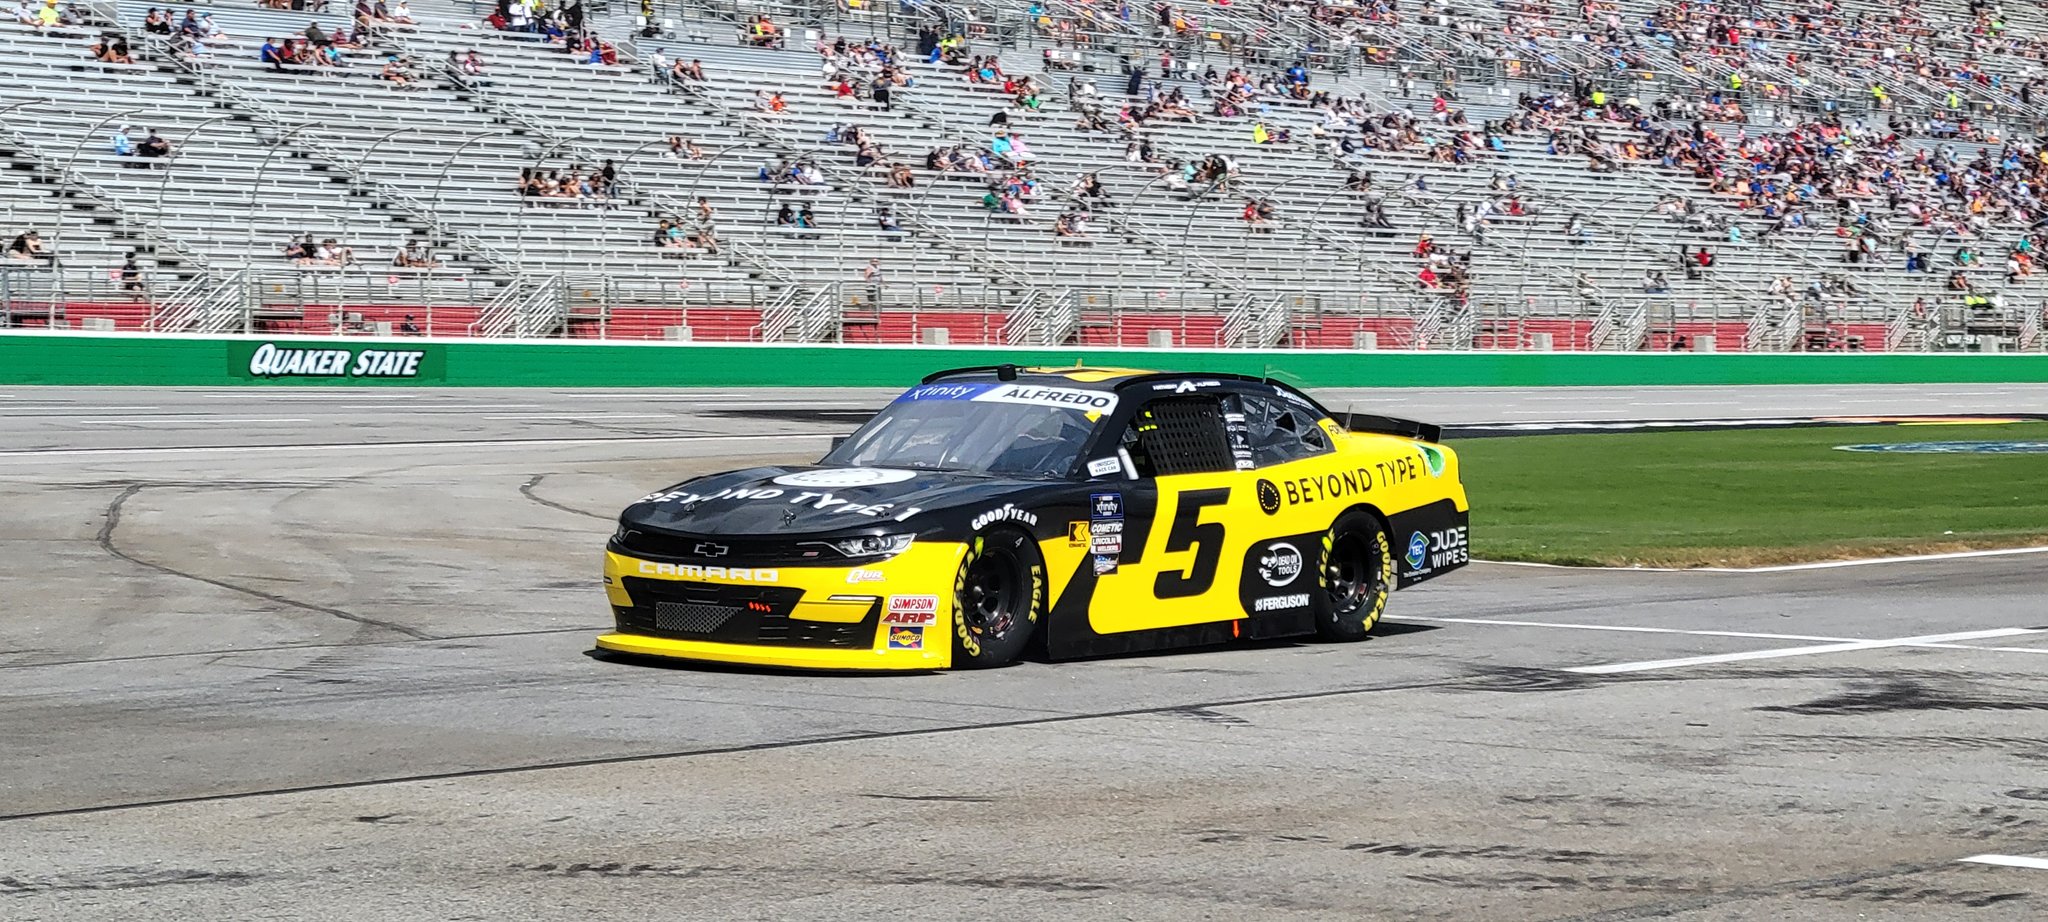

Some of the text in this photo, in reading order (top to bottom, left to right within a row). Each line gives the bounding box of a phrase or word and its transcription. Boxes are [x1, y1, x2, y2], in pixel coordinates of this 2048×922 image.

[250, 343, 424, 375] QUAKER STATE
[908, 385, 976, 400] xfinity
[1002, 388, 1110, 409] ALFREDO
[1284, 467, 1372, 506] BEYOND
[1376, 456, 1416, 488] TYPE
[790, 492, 894, 516] TYPE
[895, 507, 922, 522] 1
[1096, 501, 1118, 513] xfinity
[1091, 523, 1123, 533] COMETIC
[1092, 537, 1117, 545] LINCOLN
[1153, 487, 1232, 600] 5
[1431, 526, 1467, 552] DUDE
[1411, 544, 1423, 556] TEC
[1431, 547, 1468, 569] WIPES
[639, 561, 779, 582] CAMARO
[1278, 565, 1298, 576] TOOLS
[892, 598, 934, 610] SIMPSON
[1028, 564, 1042, 625] EAGLE
[1263, 594, 1310, 611] FERGUSON
[883, 613, 935, 623] ARP
